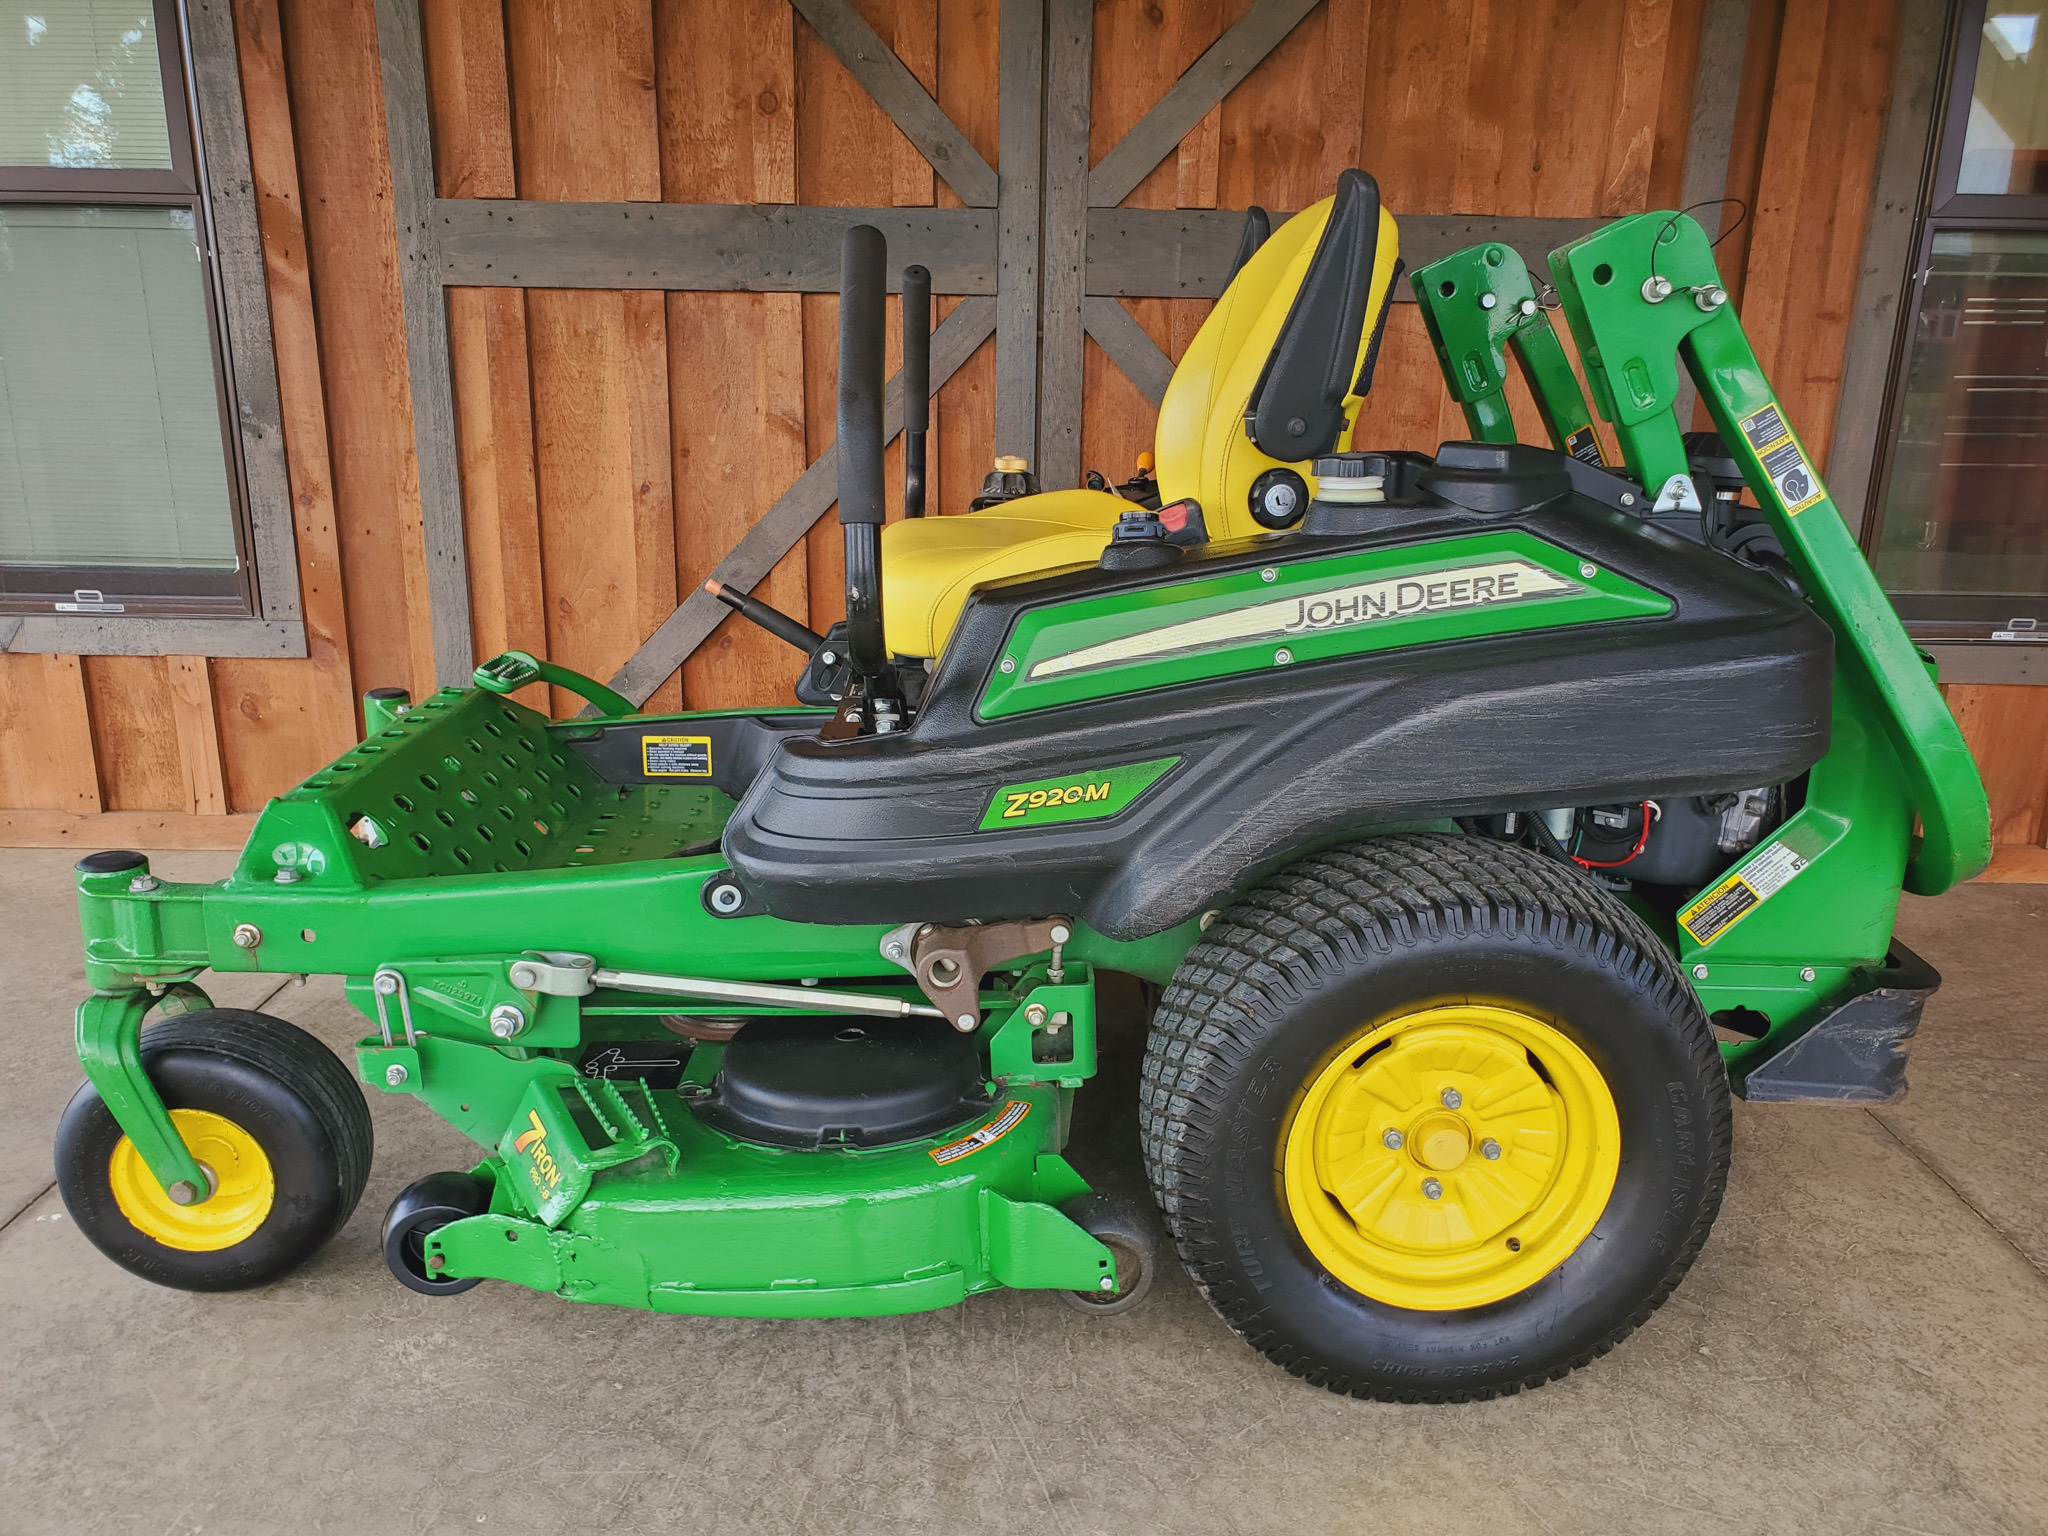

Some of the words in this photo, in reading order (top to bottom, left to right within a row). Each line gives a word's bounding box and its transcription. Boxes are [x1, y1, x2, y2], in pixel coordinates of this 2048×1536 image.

[1790, 496, 1817, 514] CAUTION
[1285, 591, 1386, 632] JOHN
[1396, 572, 1519, 611] DEERE
[1002, 781, 1112, 819] Z920M
[529, 1166, 541, 1186] PRO
